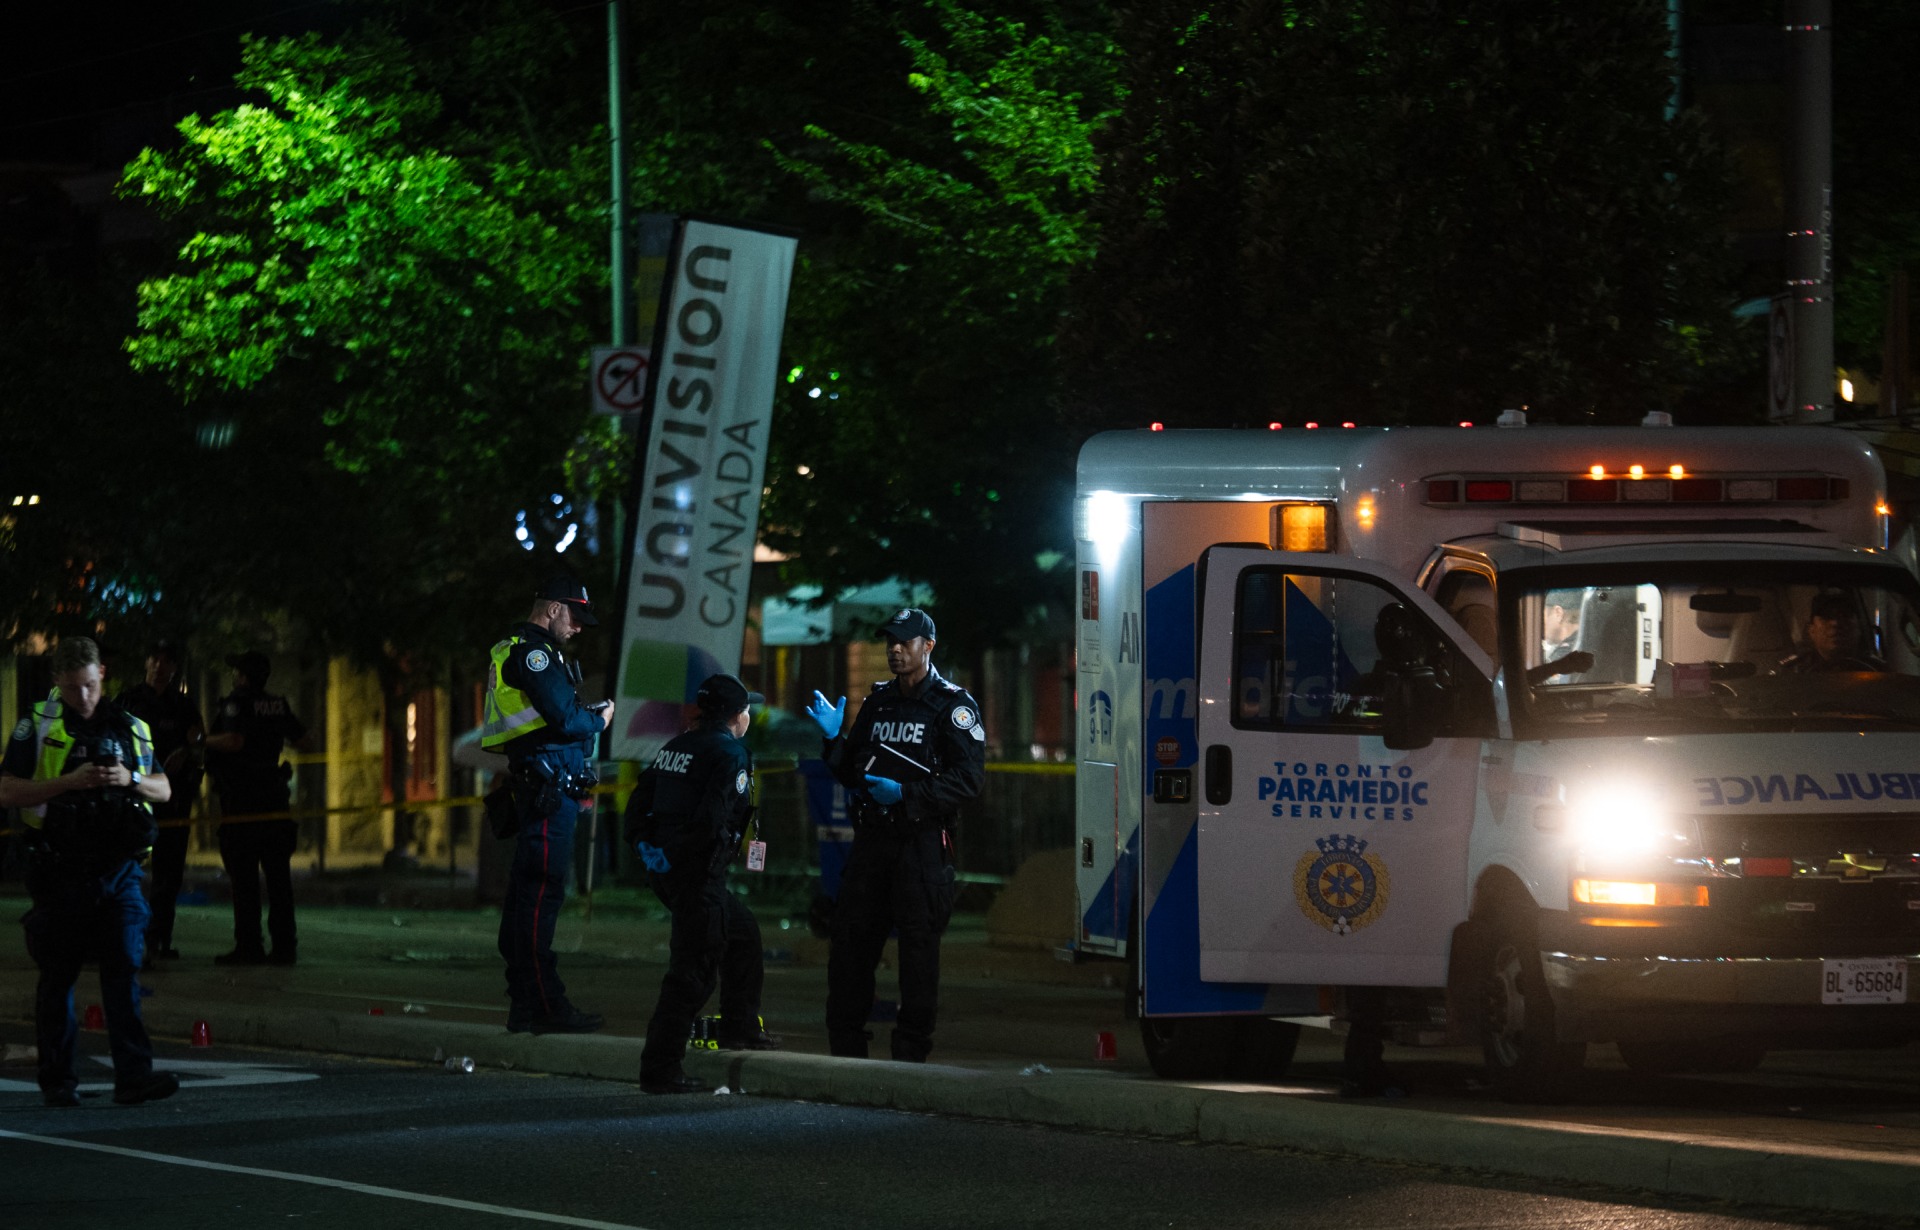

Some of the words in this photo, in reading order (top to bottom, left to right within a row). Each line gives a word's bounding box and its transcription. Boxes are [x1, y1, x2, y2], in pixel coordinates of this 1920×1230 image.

[700, 420, 760, 628] CANADA
[870, 721, 926, 744] POLICE
[1157, 742, 1178, 752] STOP
[653, 749, 693, 774] POLICE
[1274, 762, 1413, 778] TORONTO
[1258, 777, 1429, 806] PARAMEDIC
[1272, 803, 1415, 821] SERVICES
[1826, 971, 1844, 993] BL
[1855, 971, 1902, 993] 65684
